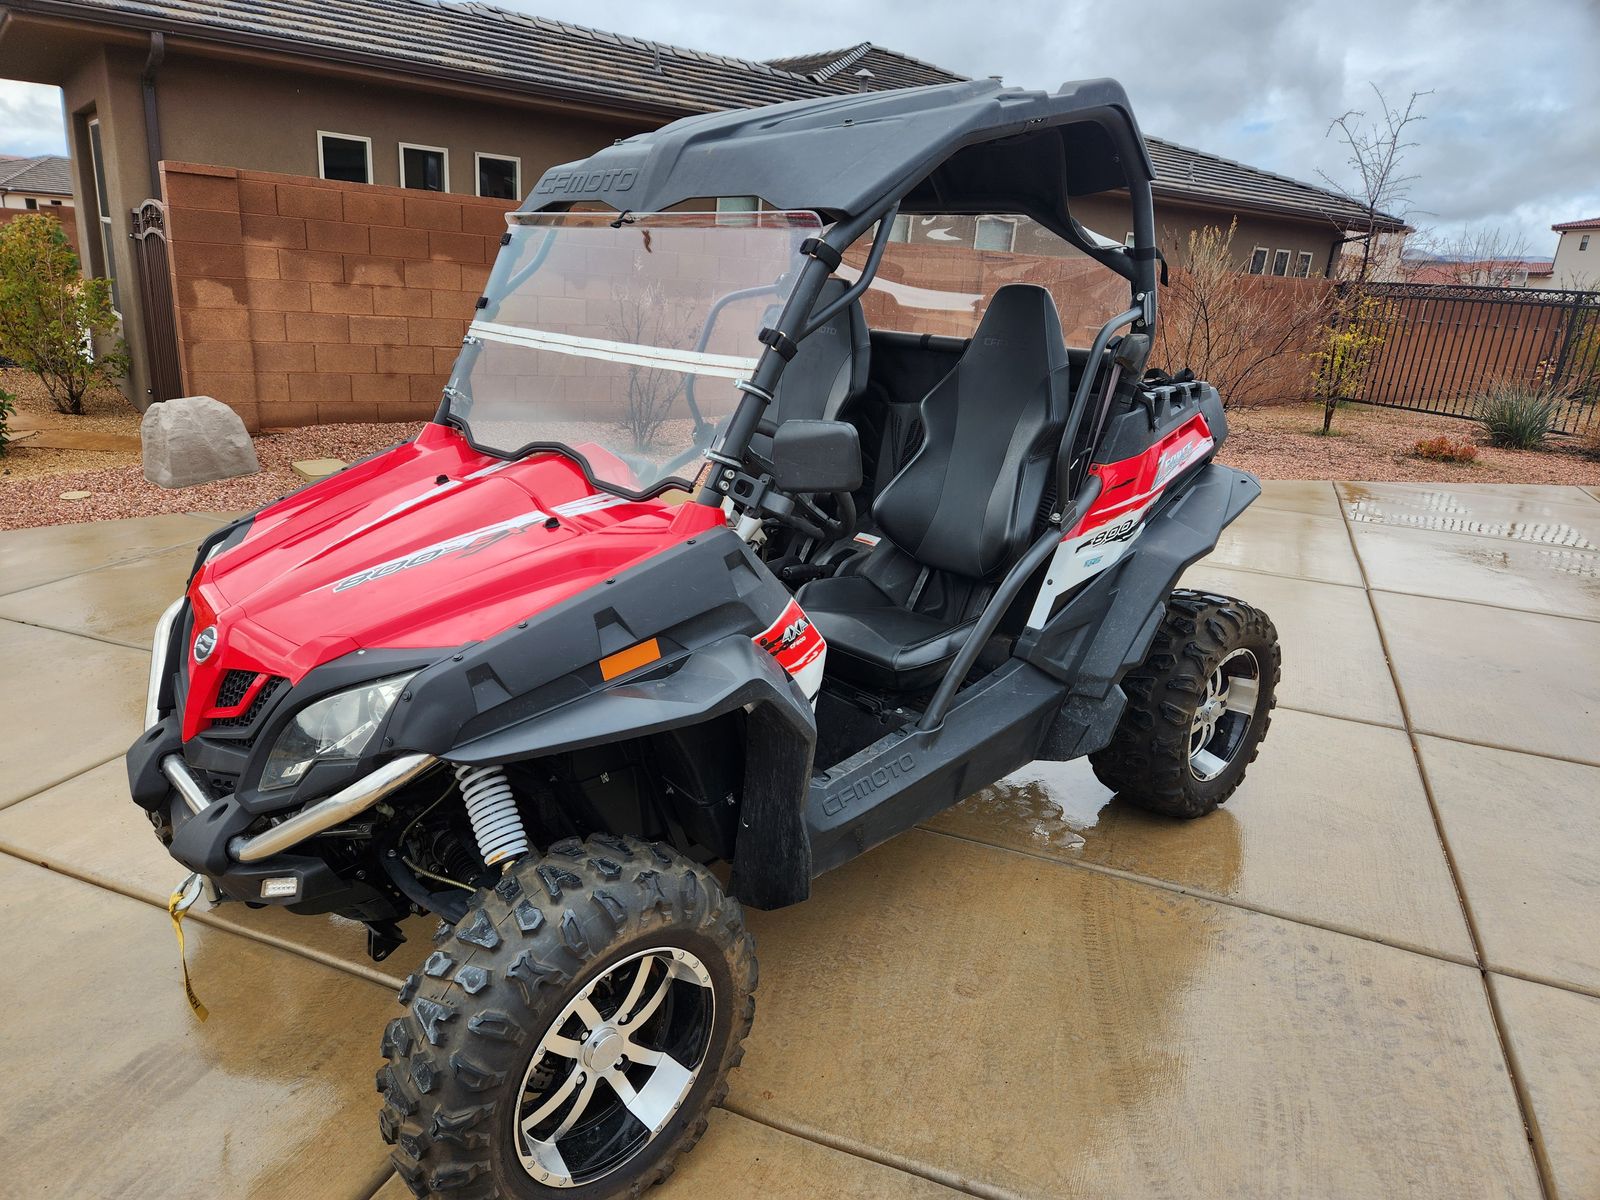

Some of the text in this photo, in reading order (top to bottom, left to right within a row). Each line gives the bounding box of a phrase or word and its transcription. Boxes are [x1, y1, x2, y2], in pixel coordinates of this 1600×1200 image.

[537, 168, 640, 195] CFMOTO
[1091, 519, 1134, 547] 800
[332, 548, 444, 593] 800
[822, 752, 916, 816] CFMOTO
